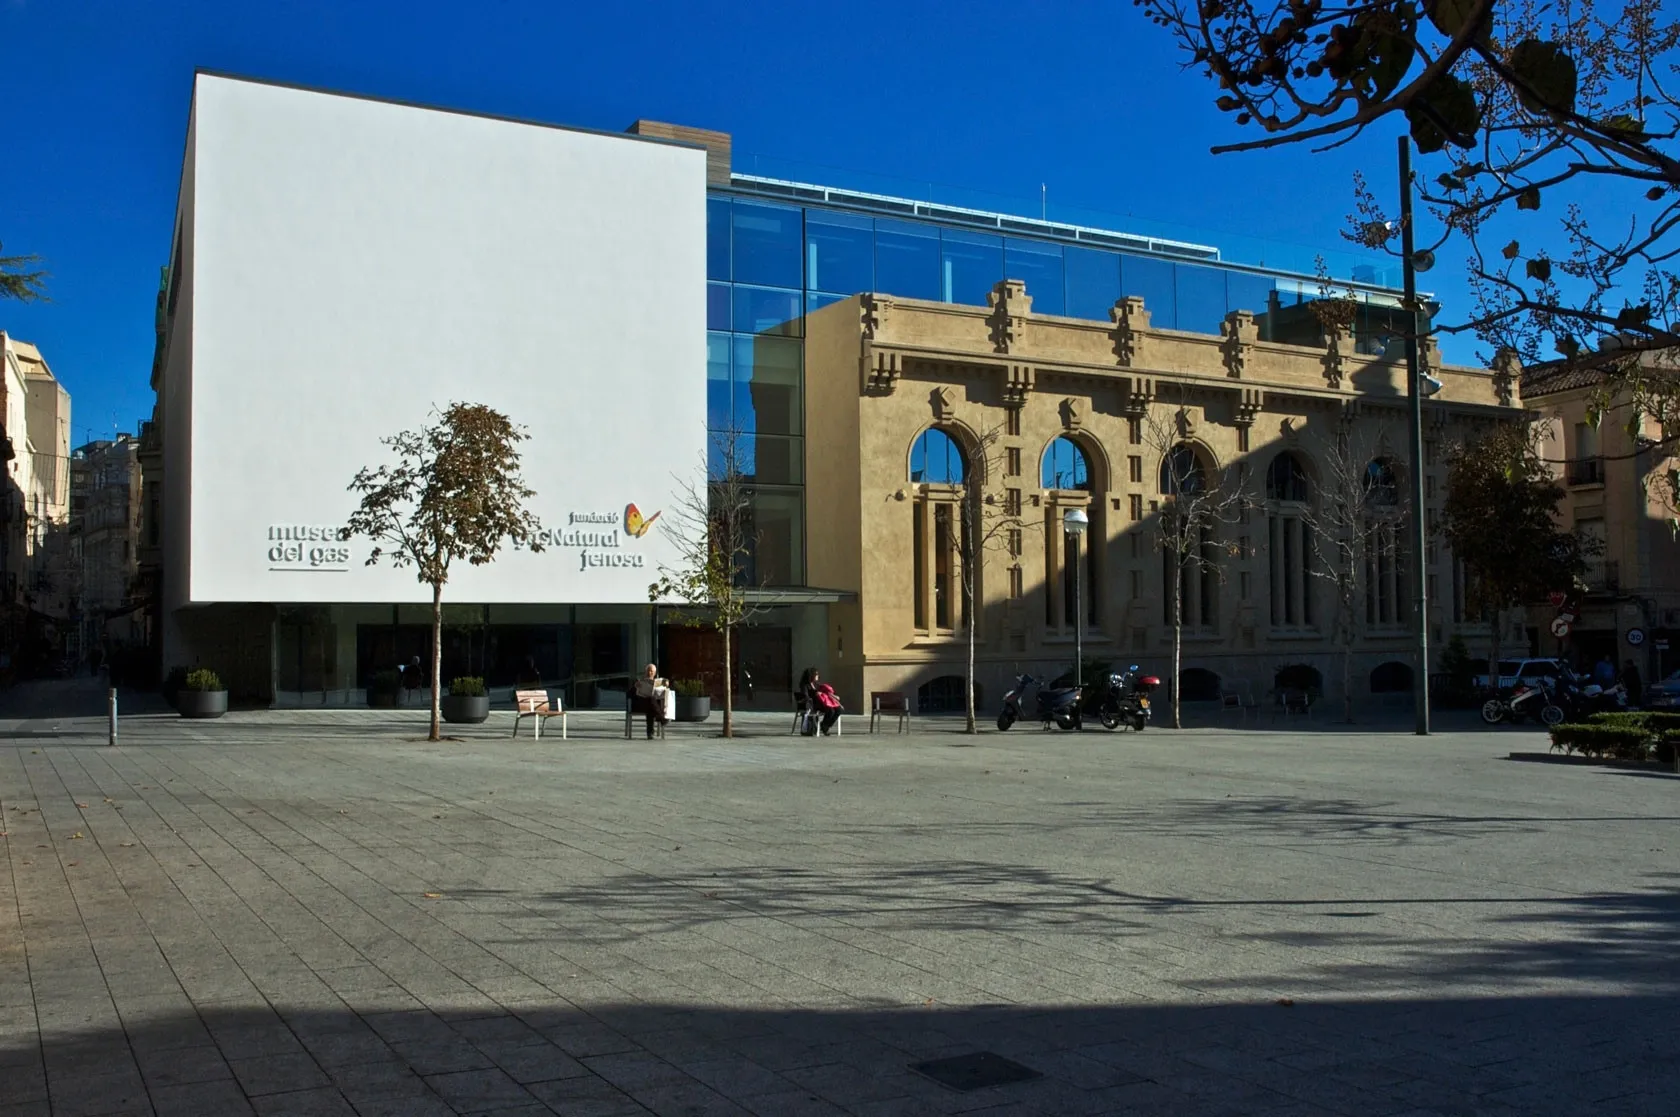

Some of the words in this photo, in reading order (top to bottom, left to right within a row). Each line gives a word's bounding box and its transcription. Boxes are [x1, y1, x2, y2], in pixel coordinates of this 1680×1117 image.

[268, 542, 303, 562] del
[309, 547, 350, 567] gas
[579, 549, 645, 572] fenosa
